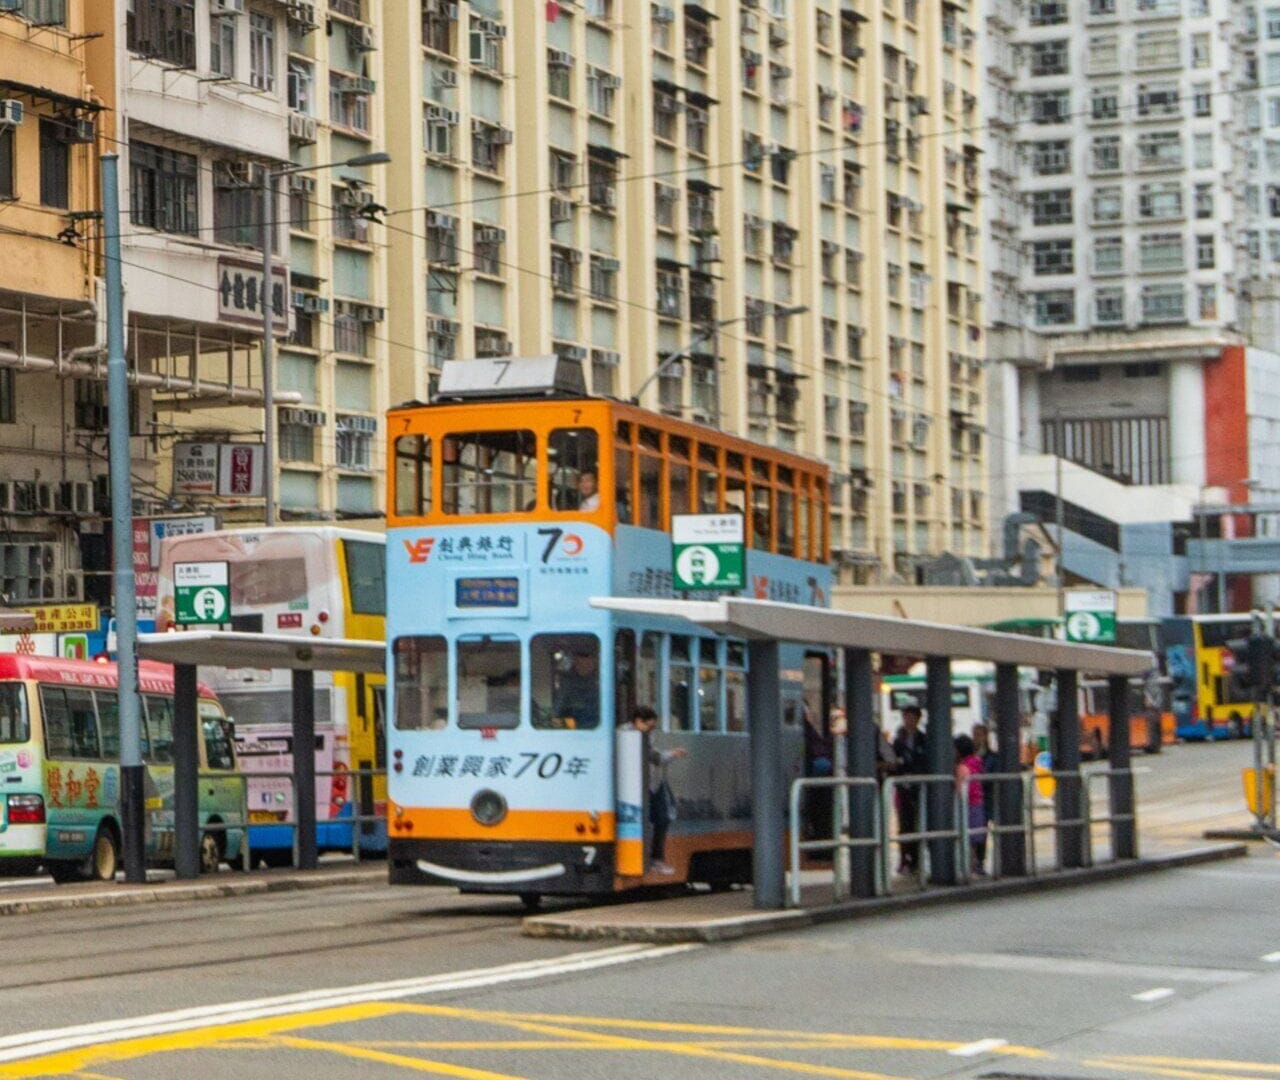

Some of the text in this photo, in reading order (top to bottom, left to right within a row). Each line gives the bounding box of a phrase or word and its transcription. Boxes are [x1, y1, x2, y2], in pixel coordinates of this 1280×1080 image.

[493, 360, 513, 385] 7
[402, 418, 412, 432] 7
[572, 409, 582, 424] 7
[581, 846, 597, 865] 7
